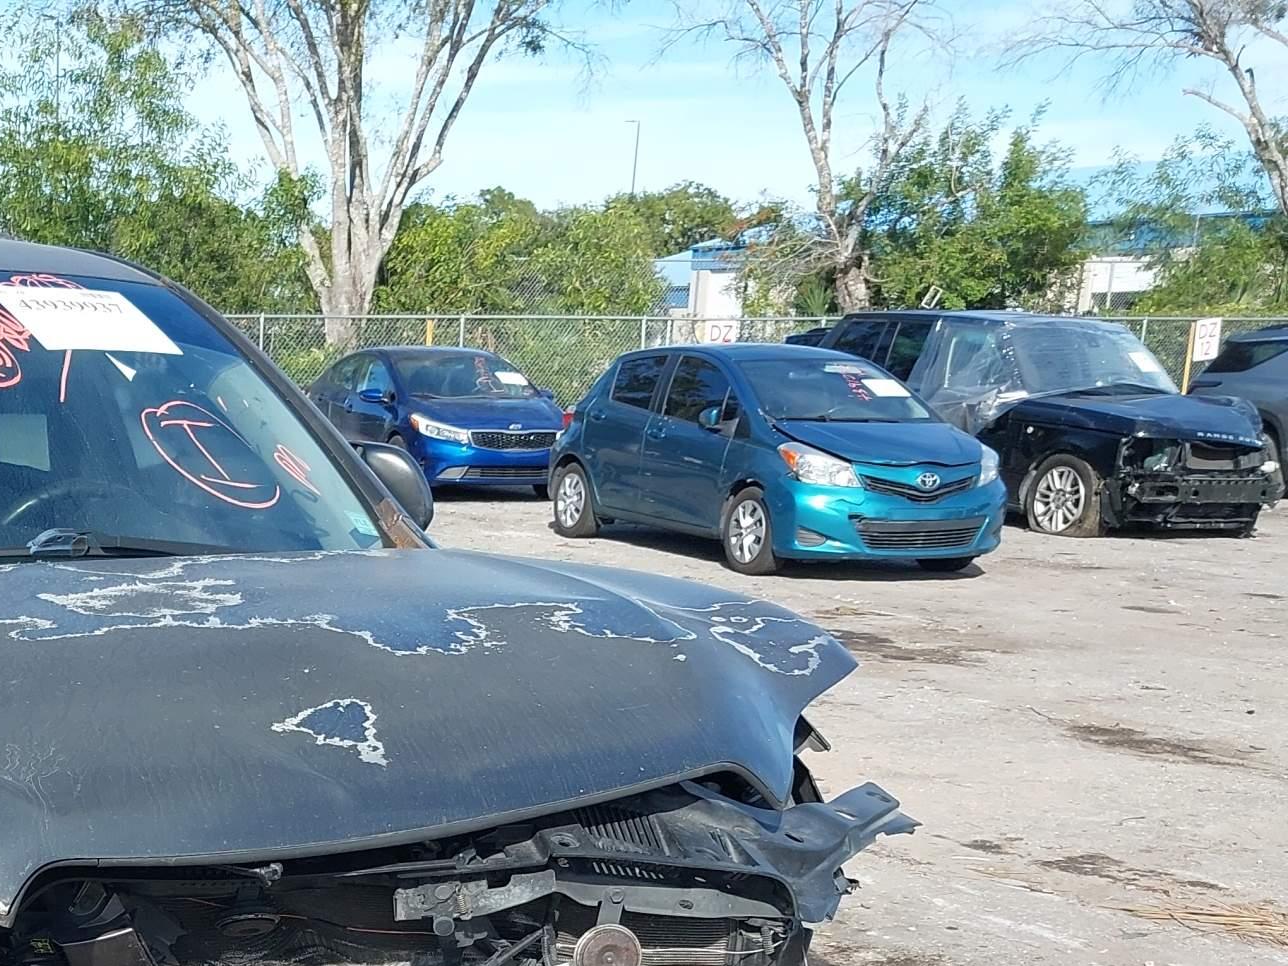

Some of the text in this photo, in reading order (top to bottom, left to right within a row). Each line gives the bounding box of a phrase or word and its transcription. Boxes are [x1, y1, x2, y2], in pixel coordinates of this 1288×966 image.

[18, 298, 124, 314] 43939937
[711, 324, 732, 342] DZ
[1199, 322, 1217, 339] DZ
[1201, 341, 1211, 356] 12
